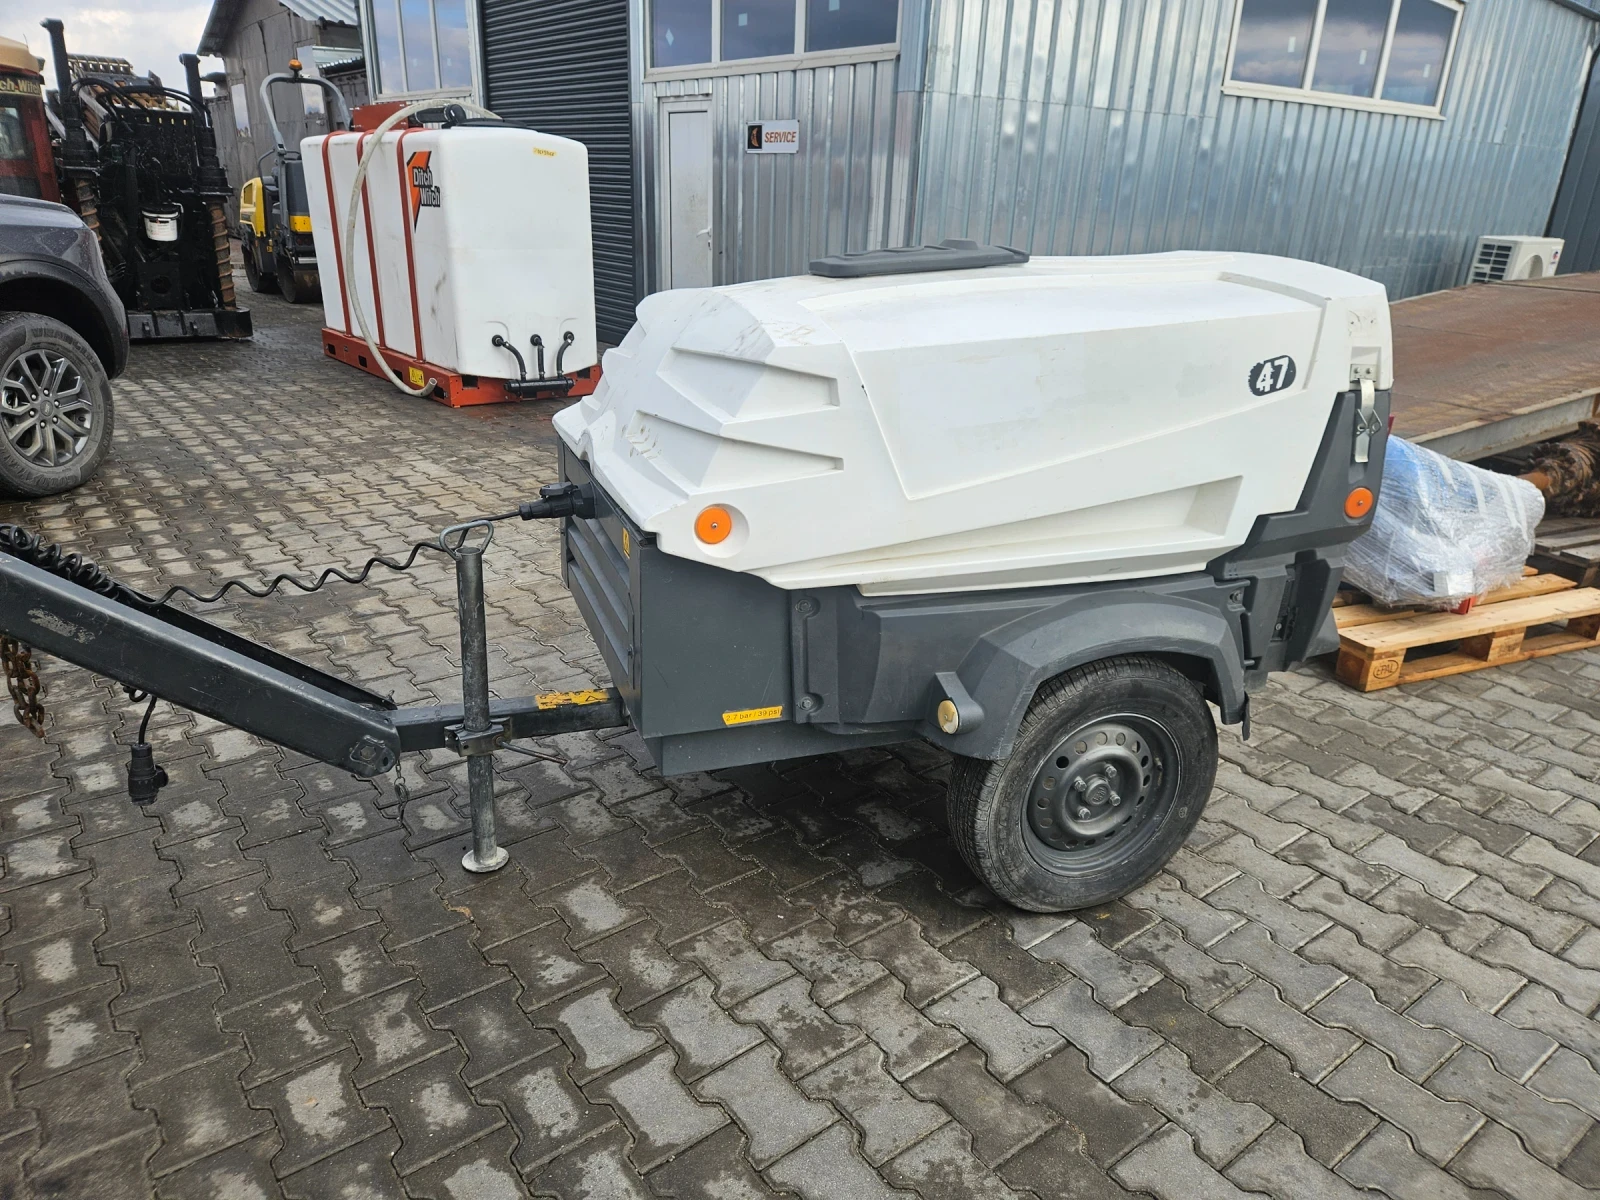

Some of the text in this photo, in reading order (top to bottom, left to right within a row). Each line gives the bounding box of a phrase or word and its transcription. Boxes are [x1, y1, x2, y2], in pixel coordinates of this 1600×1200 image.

[764, 131, 797, 143] SERVICE
[412, 165, 433, 187] Ditch
[419, 185, 441, 207] Witch
[1255, 356, 1290, 393] 47
